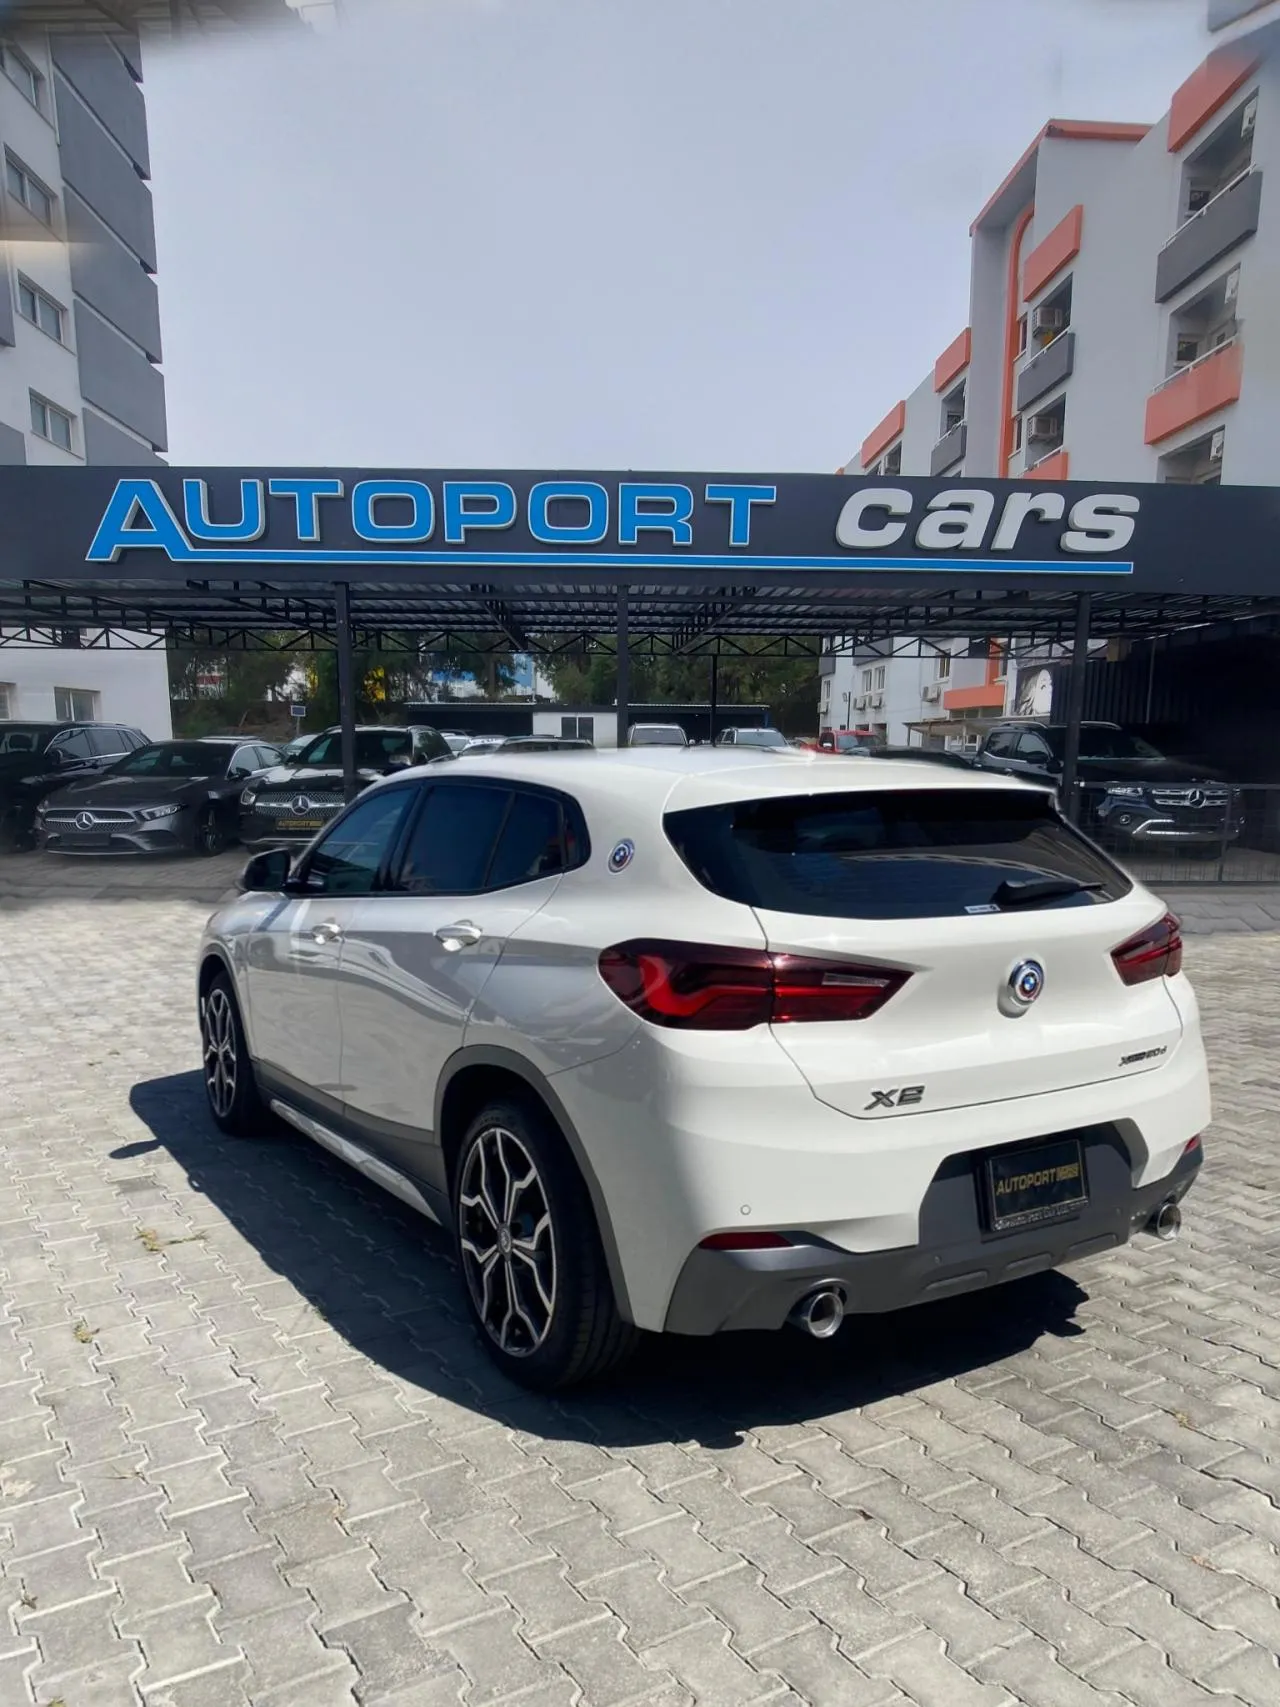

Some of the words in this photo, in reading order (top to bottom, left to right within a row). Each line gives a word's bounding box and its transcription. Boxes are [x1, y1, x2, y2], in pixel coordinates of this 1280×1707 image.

[85, 478, 778, 563] AUTOPORT
[835, 486, 1141, 553] cars
[996, 1168, 1056, 1196] AUTOPORT
